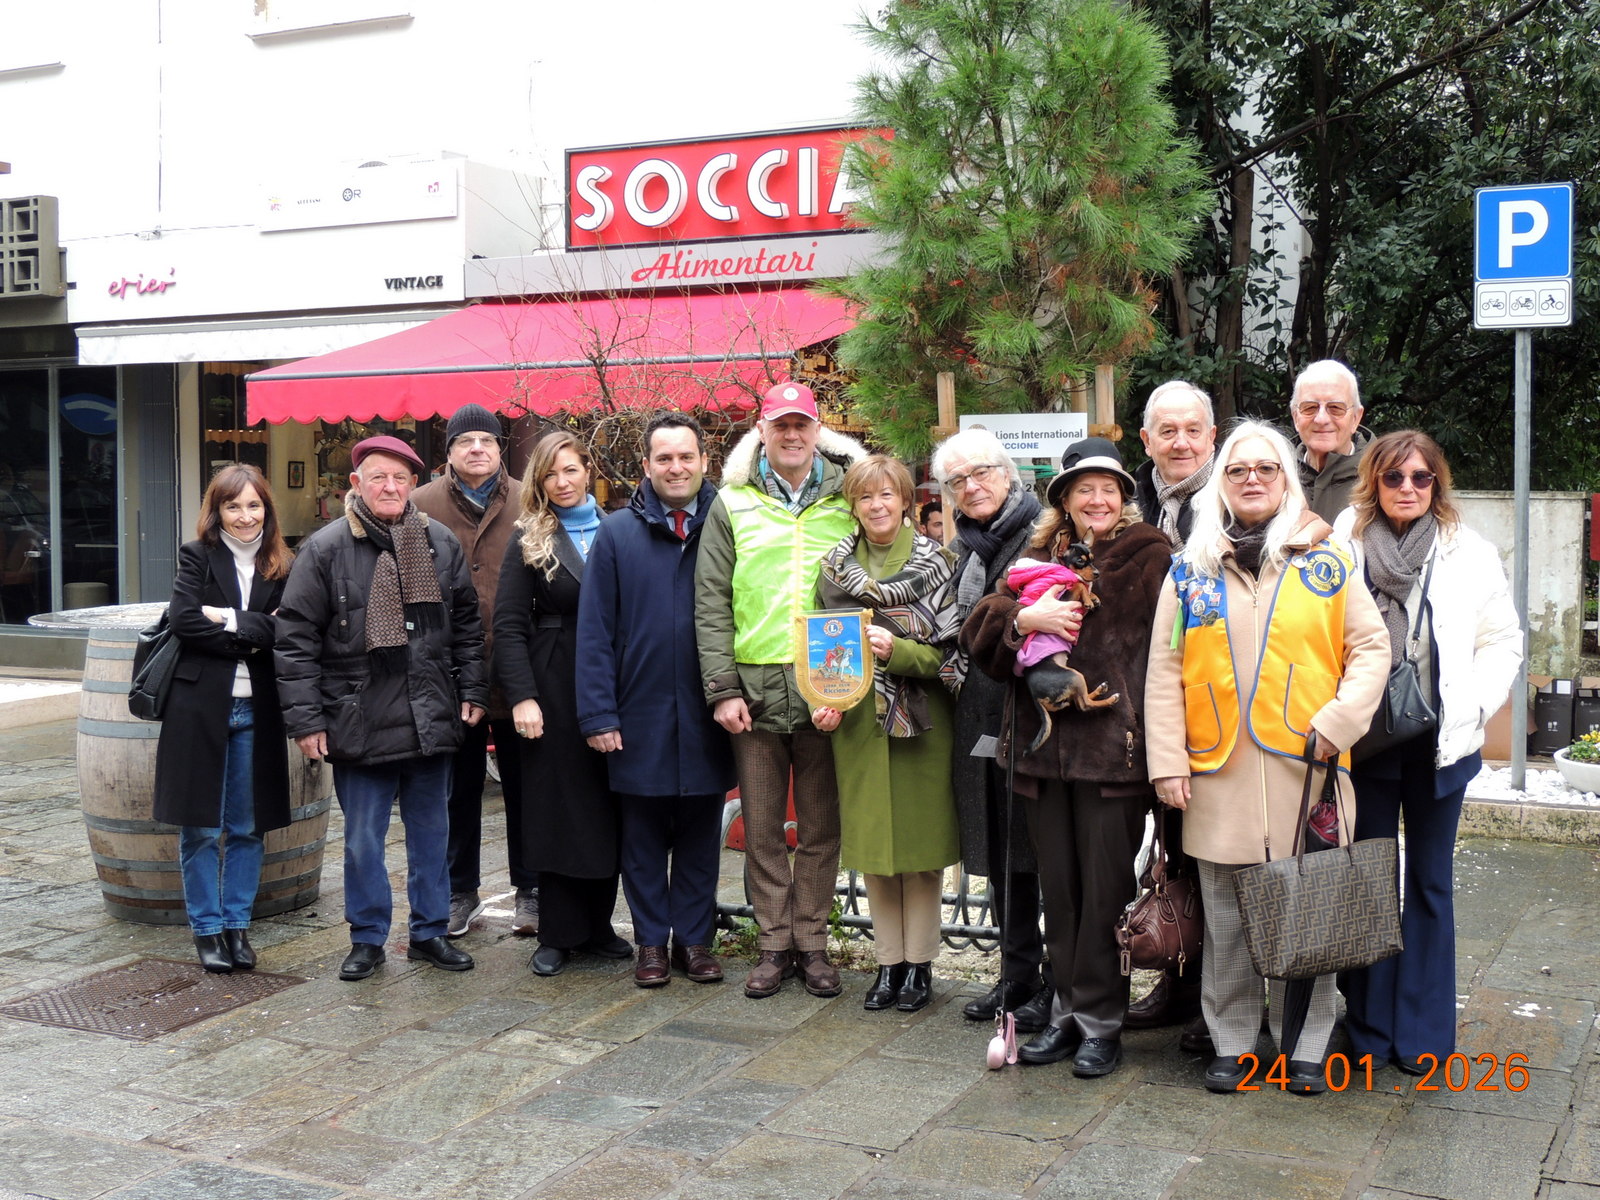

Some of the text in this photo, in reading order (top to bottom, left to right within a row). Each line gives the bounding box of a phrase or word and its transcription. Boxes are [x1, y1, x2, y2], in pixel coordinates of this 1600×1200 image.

[1498, 200, 1549, 268] P
[631, 241, 818, 282] Alimentari
[384, 275, 443, 290] VINTAGE
[995, 429, 1083, 440] Lions International
